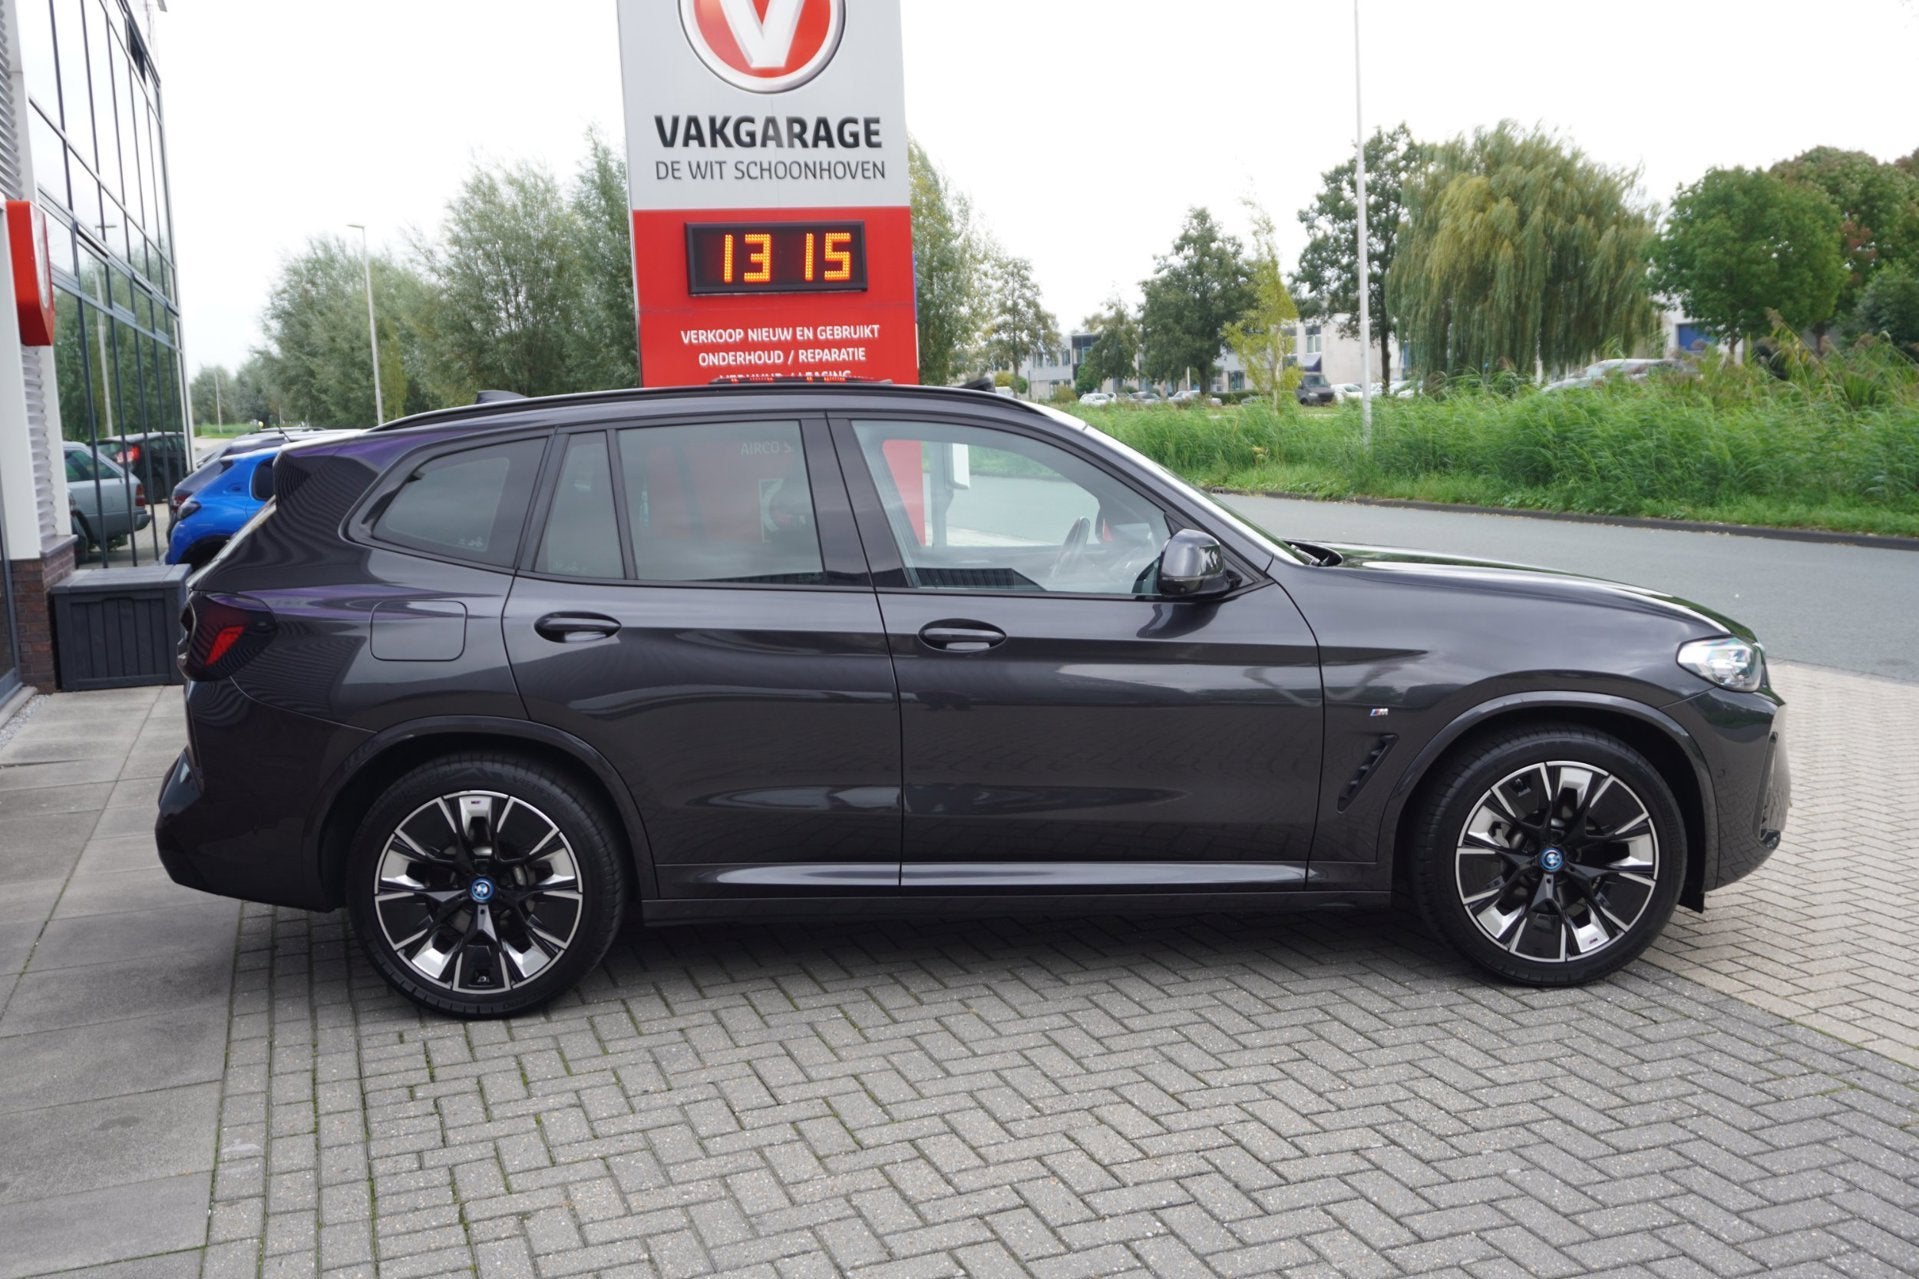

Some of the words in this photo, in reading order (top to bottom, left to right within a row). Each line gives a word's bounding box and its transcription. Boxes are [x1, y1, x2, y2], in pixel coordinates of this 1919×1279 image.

[719, 0, 805, 69] V
[654, 115, 883, 149] VAKGARAGE
[655, 160, 682, 180] DE
[688, 160, 727, 180] WIT
[734, 160, 886, 180] SCHOONHOVEN
[723, 233, 771, 283] 13
[804, 232, 851, 281] 15
[681, 328, 744, 345] VERKOOP
[748, 326, 793, 342] NIEUW
[796, 325, 814, 341] EN
[817, 324, 880, 340] GEBRUIKT
[698, 350, 784, 367] ONDERHOUD
[787, 350, 795, 365] /
[798, 347, 867, 363] REPARATIE
[740, 441, 780, 456] AIRCO
